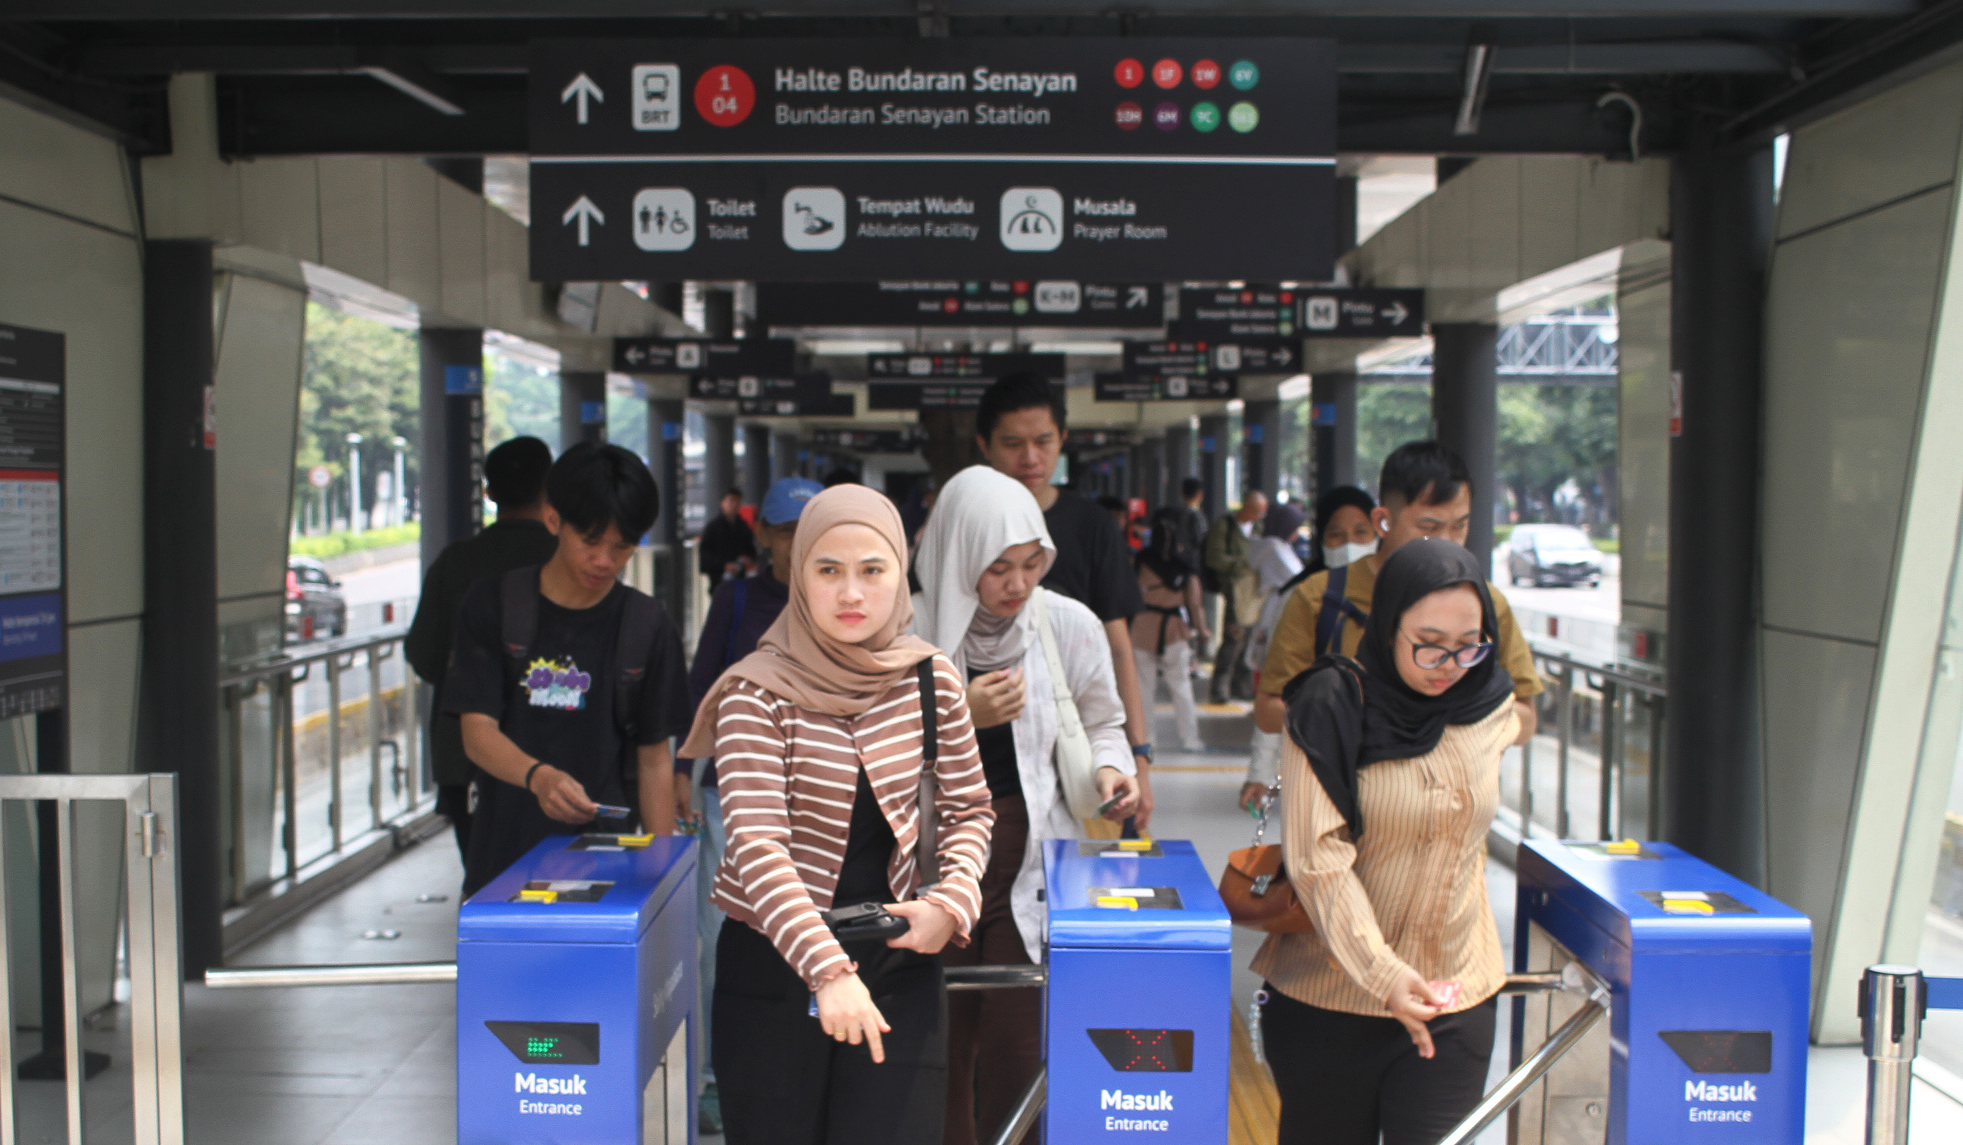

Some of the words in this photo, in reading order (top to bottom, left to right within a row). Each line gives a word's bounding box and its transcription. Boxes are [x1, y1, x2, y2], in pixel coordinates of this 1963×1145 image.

[720, 74, 731, 92] 1
[775, 69, 841, 92] Halte
[848, 69, 967, 92] Bundaran
[973, 68, 1077, 97] Senayan
[1124, 68, 1134, 81] 1
[712, 96, 738, 115] 04
[641, 110, 670, 124] BRT
[775, 104, 875, 125] Bundaran
[881, 104, 969, 129] Senayan
[975, 104, 1051, 125] Station
[707, 197, 756, 217] Toilet
[857, 197, 921, 218] Tempat
[924, 197, 975, 215] Wudu
[1073, 198, 1137, 216] Musala
[707, 223, 749, 240] Toilet
[857, 222, 920, 240] Ablution
[923, 223, 979, 243] Facility
[1073, 223, 1121, 243] Prayer
[1124, 223, 1168, 240] Room
[1312, 303, 1332, 322] M
[514, 1071, 587, 1096] Masuk
[1685, 1079, 1757, 1103] Masuk
[519, 1099, 583, 1116] Entrance
[1100, 1089, 1174, 1112] Masuk
[1105, 1116, 1170, 1132] Entrance
[1689, 1107, 1752, 1123] Entrance
